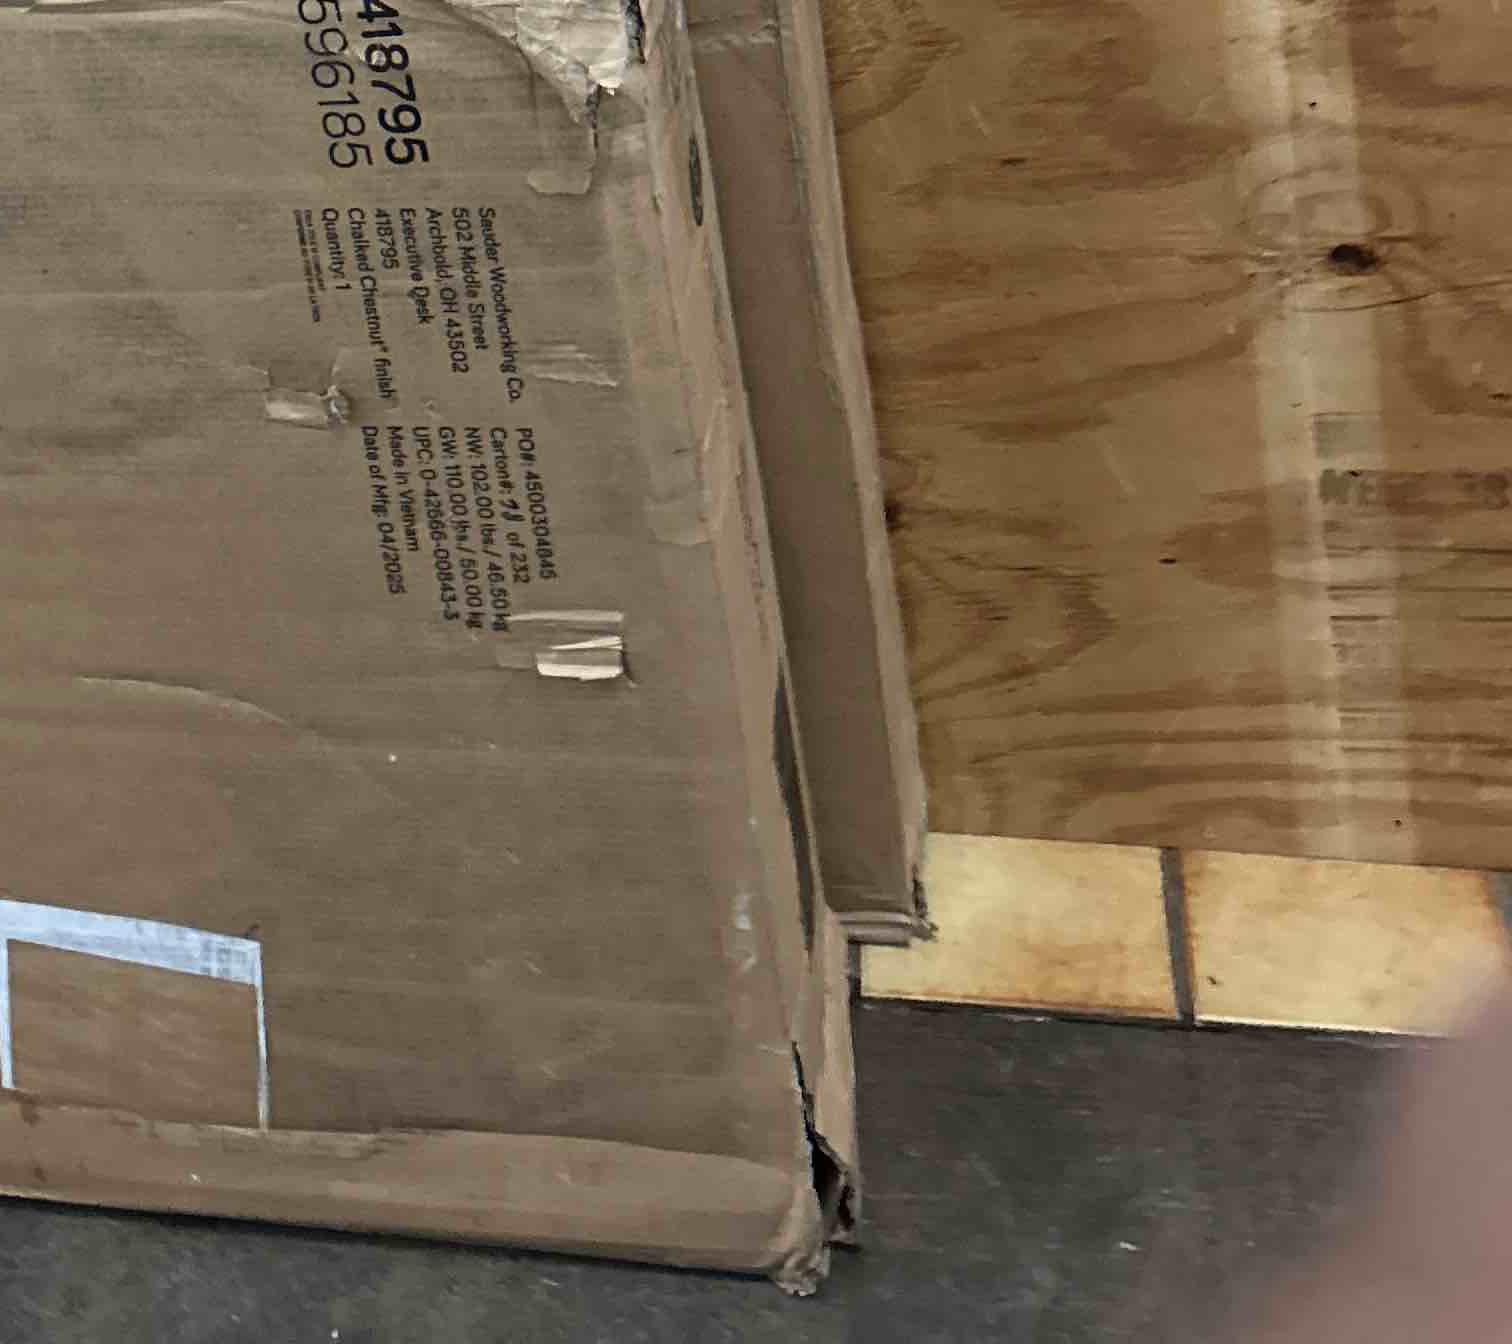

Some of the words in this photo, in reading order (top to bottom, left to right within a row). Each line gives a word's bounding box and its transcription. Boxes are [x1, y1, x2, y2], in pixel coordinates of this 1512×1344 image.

[376, 209, 399, 269] 418795
[400, 208, 423, 282] Executive
[427, 208, 453, 282] Archbold,
[452, 208, 473, 241] 502
[459, 246, 480, 298] Middle
[348, 208, 374, 272] Chalked
[375, 358, 396, 400] finish
[411, 286, 434, 324] Desk
[440, 287, 459, 313] OH
[479, 208, 500, 263] Sauder
[490, 268, 518, 373] Woodworking
[506, 377, 524, 403] Co.
[446, 318, 469, 373] 43502
[468, 303, 488, 350] Street
[362, 426, 379, 460] Date
[387, 426, 407, 467] Made
[369, 465, 386, 480] of
[393, 472, 411, 485] in
[400, 490, 418, 551] Vietnam
[506, 532, 525, 548] of
